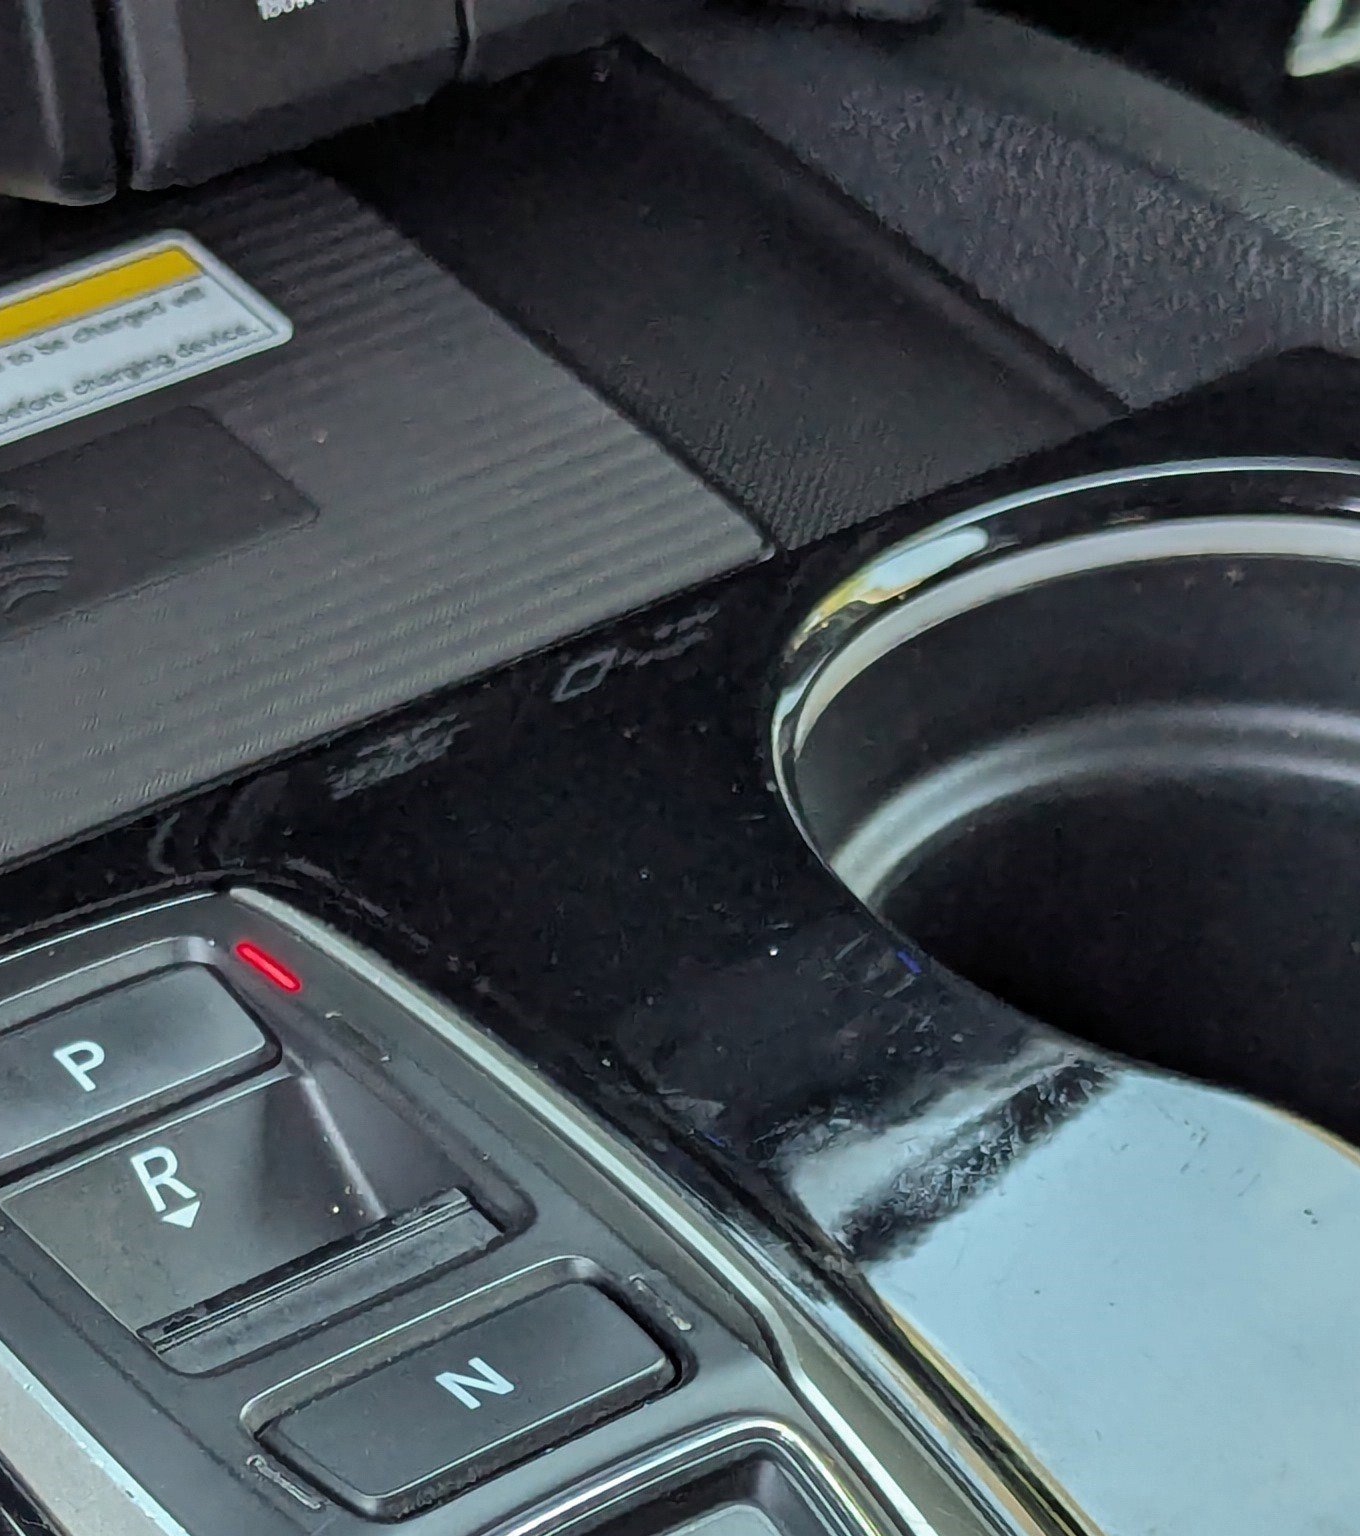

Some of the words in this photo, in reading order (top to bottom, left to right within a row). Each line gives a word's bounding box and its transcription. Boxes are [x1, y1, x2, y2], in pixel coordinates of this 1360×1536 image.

[7, 350, 34, 366] to
[37, 339, 68, 355] be
[73, 302, 167, 343] charged
[73, 354, 175, 395] charging
[53, 1040, 105, 1092] P
[130, 1145, 195, 1212] R
[435, 1358, 513, 1409] N
